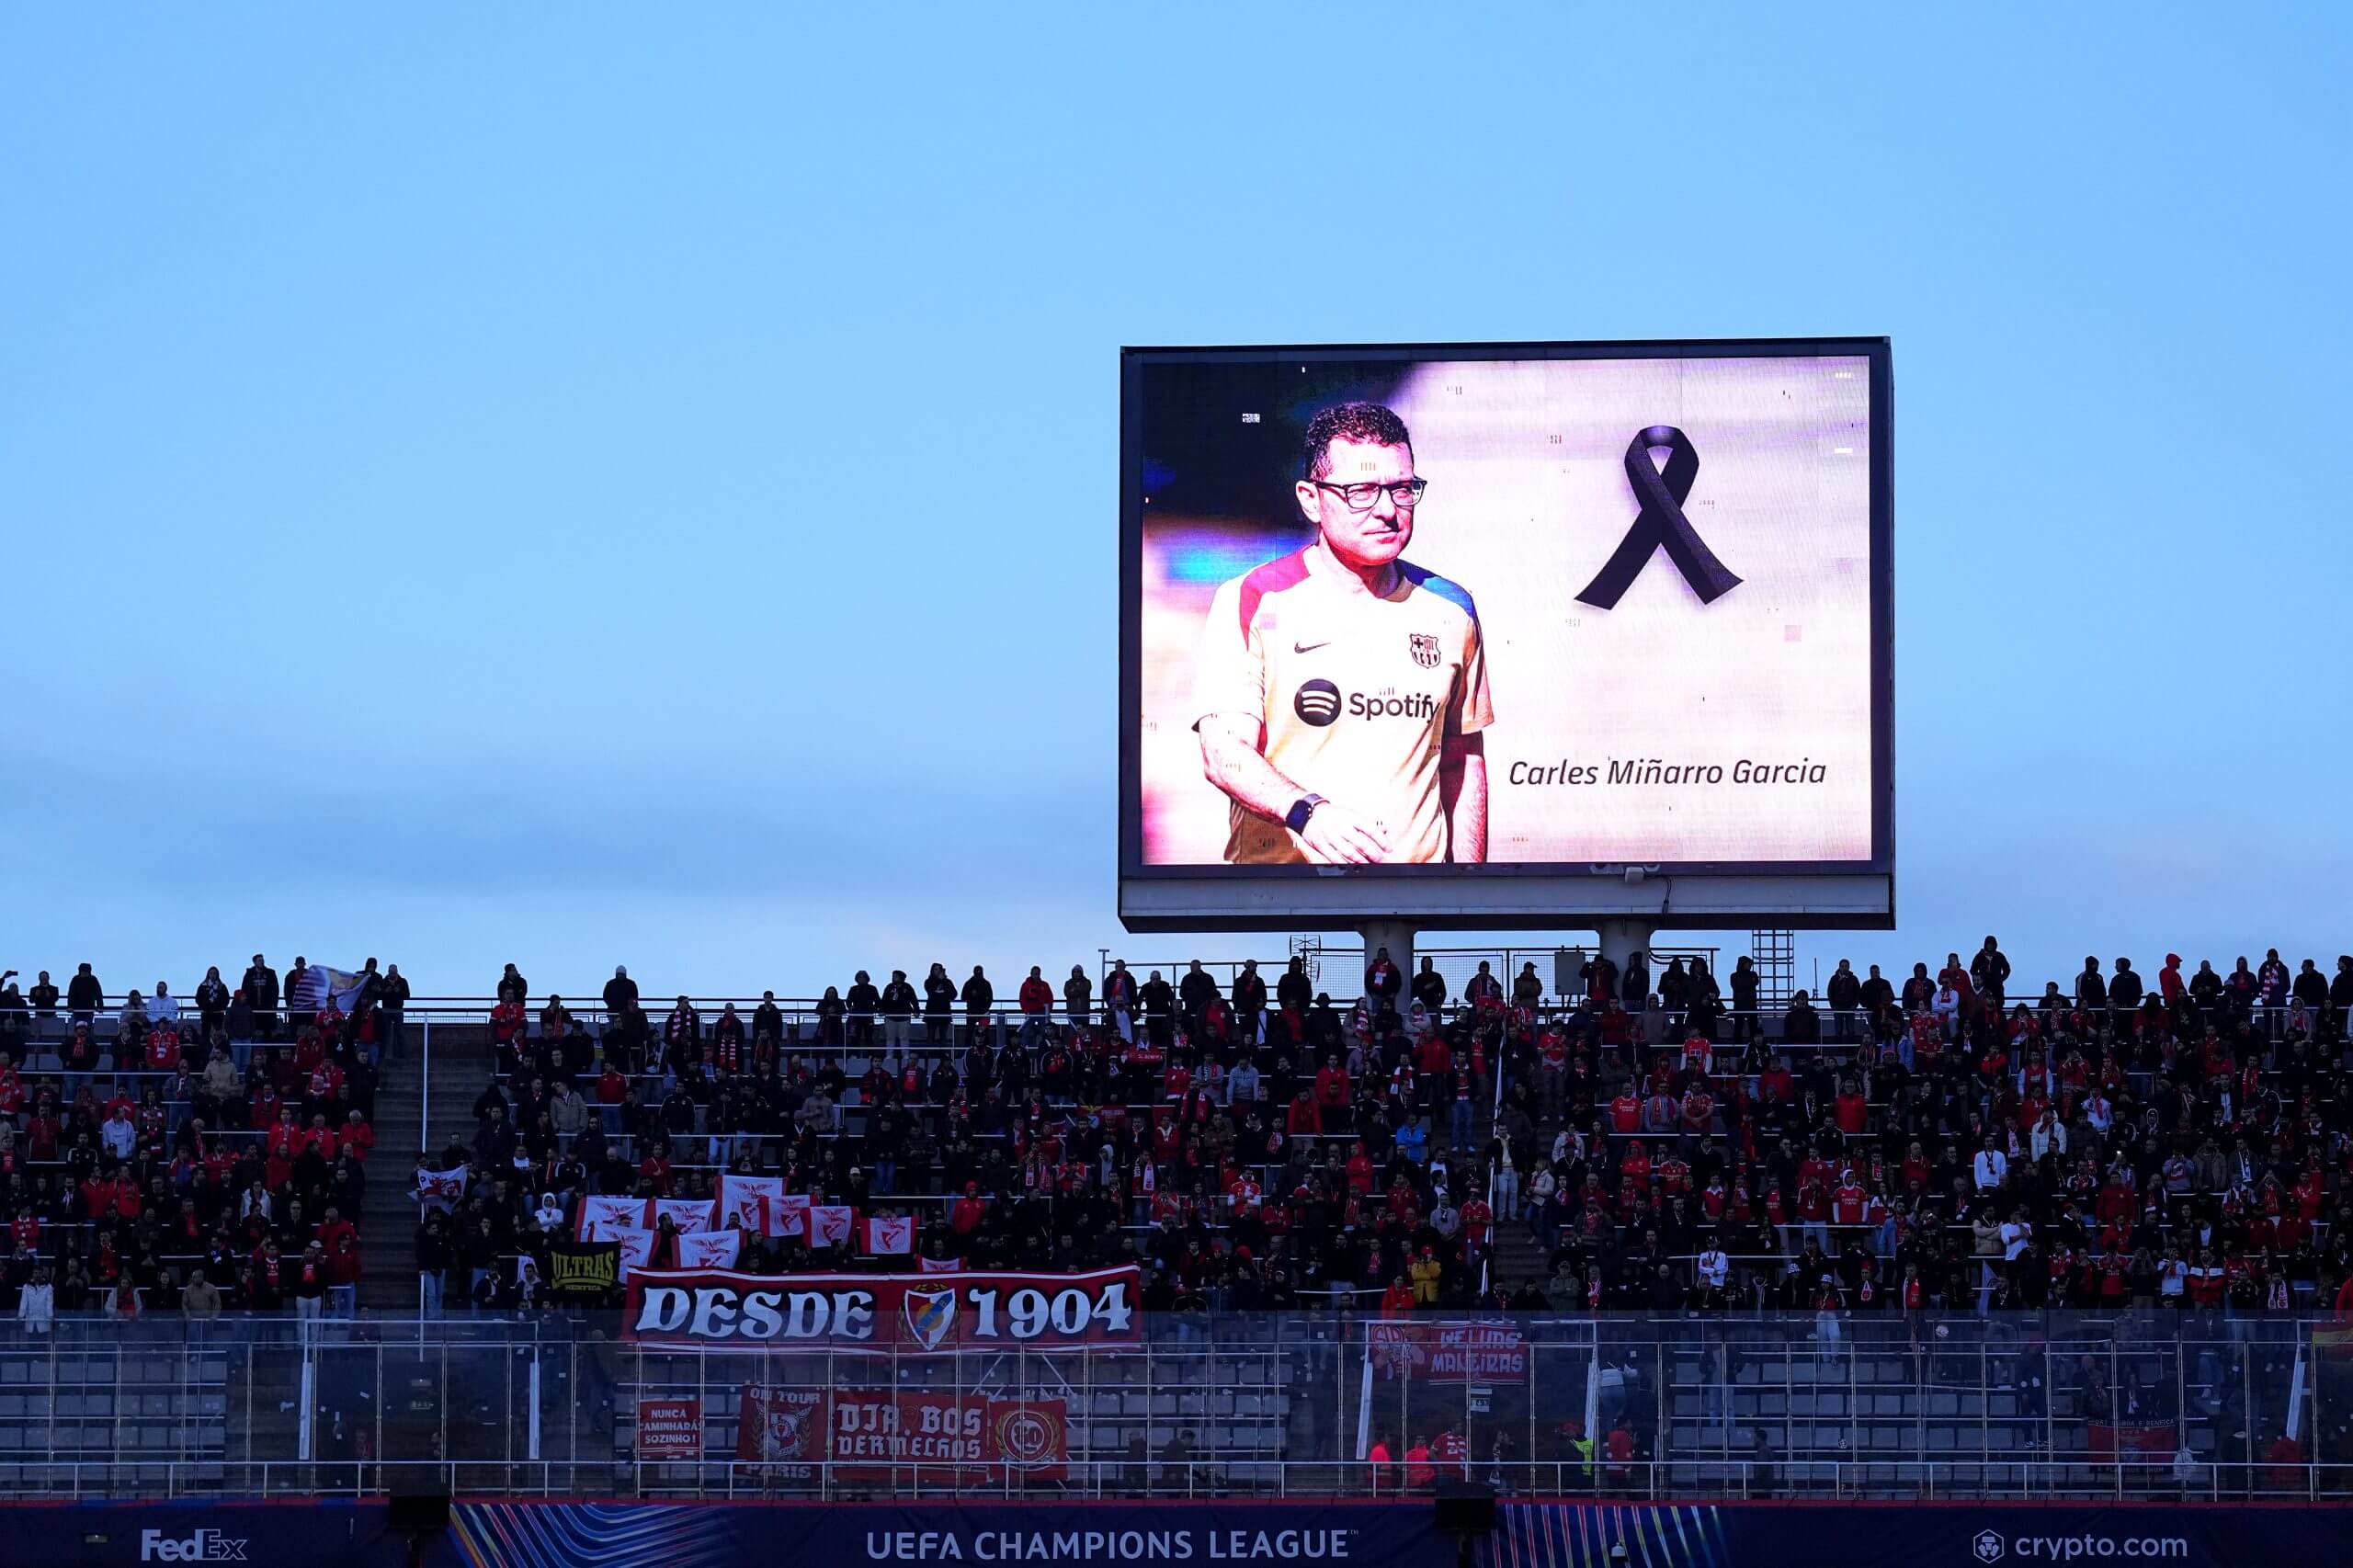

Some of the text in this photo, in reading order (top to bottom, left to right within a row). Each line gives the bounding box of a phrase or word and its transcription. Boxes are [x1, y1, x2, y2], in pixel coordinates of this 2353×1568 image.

[1349, 692, 1440, 723] Spotify
[1509, 757, 1826, 785] Carles Miñarro Garcia
[551, 1250, 615, 1282] ULTRAS
[635, 1286, 875, 1340] DESDE
[969, 1283, 1133, 1339] 1904
[778, 1390, 821, 1403] TOUR
[651, 1409, 687, 1419] NUNCA
[141, 1528, 248, 1562] FedEx
[867, 1529, 963, 1561] UEFA
[974, 1529, 1193, 1561] CHAMPIONS
[2014, 1534, 2188, 1562] crypto.com
